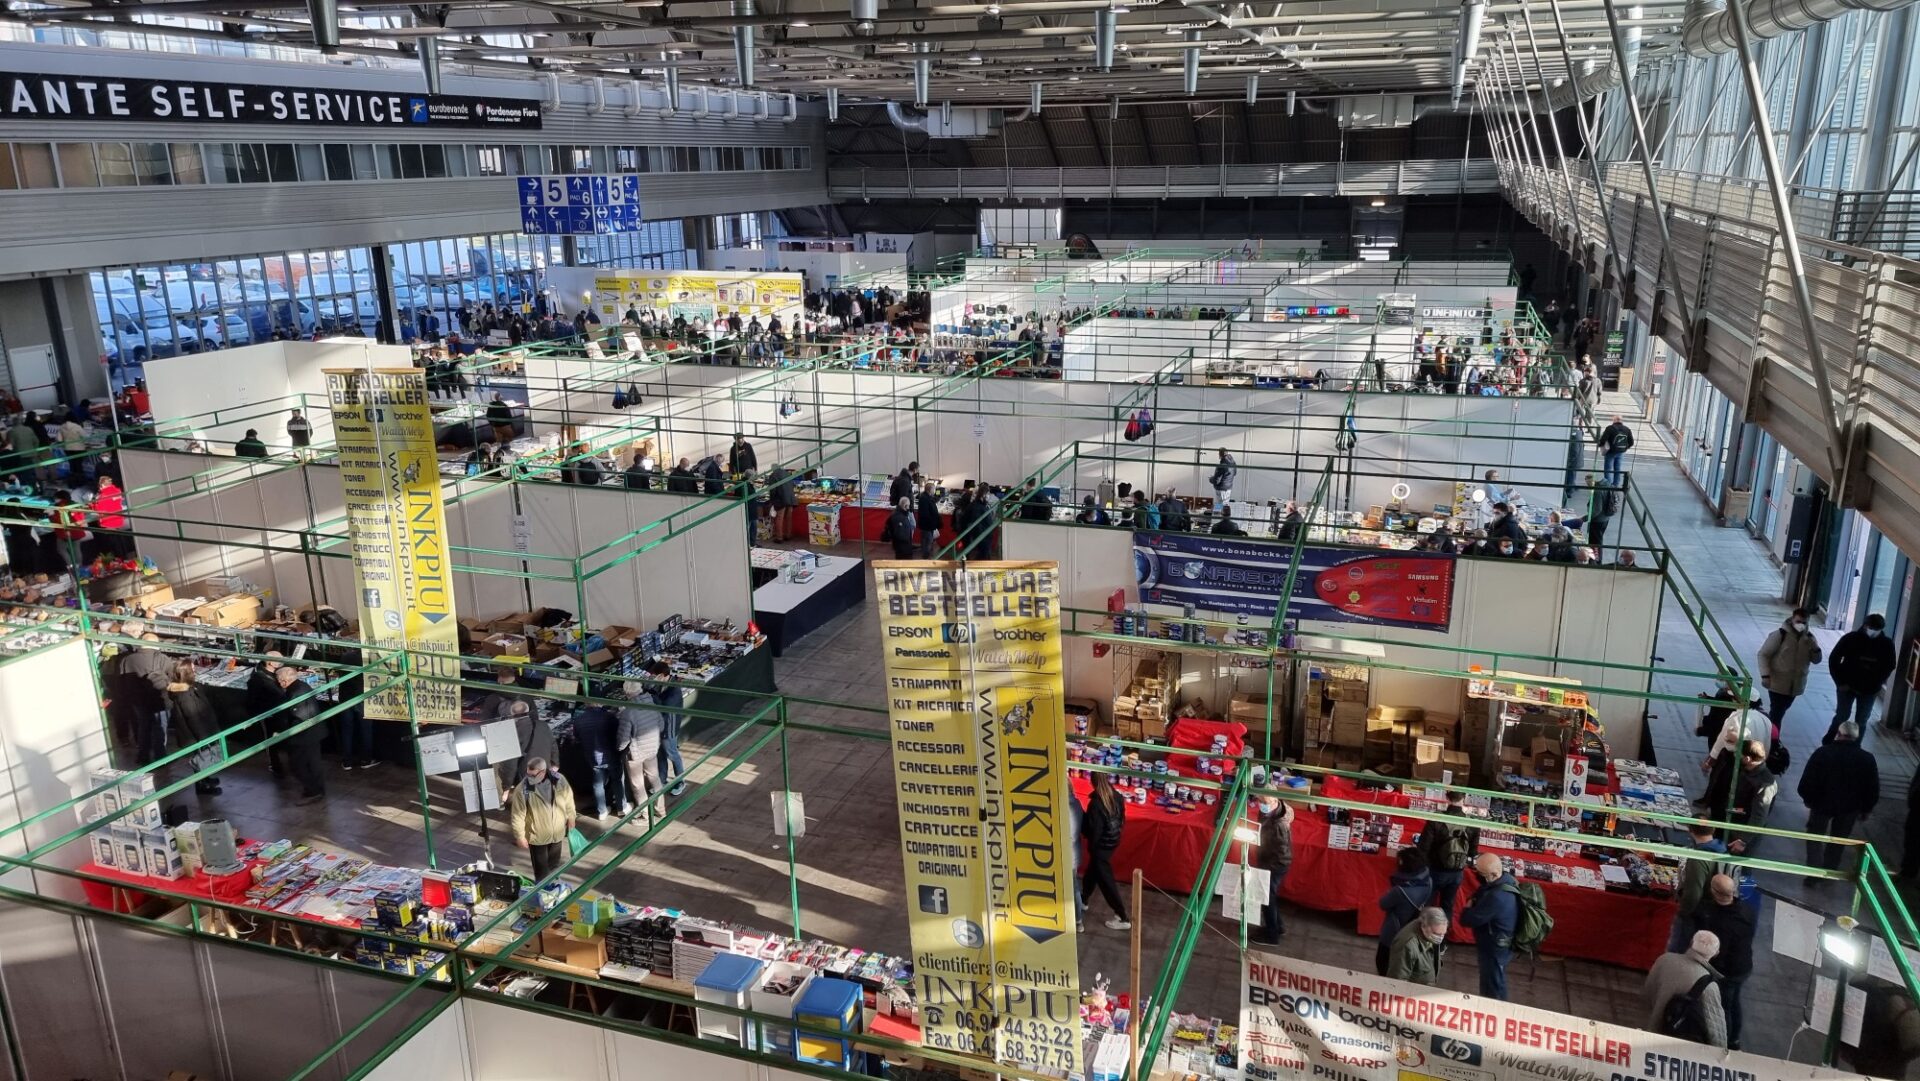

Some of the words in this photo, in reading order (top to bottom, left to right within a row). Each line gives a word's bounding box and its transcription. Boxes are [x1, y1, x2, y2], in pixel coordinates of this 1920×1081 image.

[0, 79, 130, 116] ANTE
[151, 85, 403, 122] SELF-SERVICE
[548, 180, 562, 202] 5
[582, 191, 590, 204] 6
[611, 179, 620, 201] 5
[329, 374, 424, 390] RIVENDITORE
[333, 390, 425, 406] BESTSELLER
[334, 411, 360, 420] EPSON
[393, 412, 424, 421] brother
[338, 425, 371, 433] Panasonic
[342, 461, 354, 469] KIT
[344, 475, 366, 483] TONER
[348, 503, 394, 512] CANCELLERA
[353, 543, 391, 553] CARTUCC
[407, 489, 445, 610] INKPIU
[361, 571, 391, 581] ORIGINALI
[884, 570, 1052, 594] RIVENDITORE
[1408, 573, 1439, 581] SAMSUNG
[889, 594, 1051, 618] BESTSELLER
[888, 626, 933, 639] EPSON
[993, 629, 1047, 642] brother
[895, 647, 952, 659] Panasonic
[891, 677, 963, 691] STAMPANTI
[387, 692, 457, 711] 06.4.68.37.79
[893, 698, 912, 711] KIT
[917, 699, 975, 712] RICARICA
[896, 719, 935, 733] TONER
[897, 740, 966, 755] ACCESSORI
[901, 781, 976, 797] CAVETTERIA
[903, 801, 970, 817] INCHIOSTRI
[979, 688, 1010, 923] www.inkpiu.it
[904, 820, 979, 838] CARTUCCE
[1007, 742, 1059, 926] INKPIU
[906, 840, 968, 859] COMPATIBILI
[971, 845, 978, 860] E
[918, 860, 968, 878] ORIGINALI
[918, 952, 1072, 989] clientifiera@inkpiu.it
[921, 974, 1078, 1025] INKPIU
[1249, 985, 1330, 1021] EPSON
[1338, 1007, 1424, 1042] brother
[1250, 963, 1363, 1007] RIVENDITORE
[1369, 990, 1497, 1038] AUTORIZZATO
[1504, 1018, 1632, 1068] BESTSELLER
[955, 1010, 1074, 1048] 06.9.44.33.22
[1249, 1011, 1313, 1038] LEXMARK
[1320, 1031, 1391, 1053] Panasonic
[925, 1025, 953, 1049] Fax
[957, 1031, 1075, 1071] 06.4.68.37.79
[1269, 1035, 1310, 1050] TELECOM
[1247, 1049, 1306, 1071] Canon
[1320, 1049, 1388, 1070] SHARP
